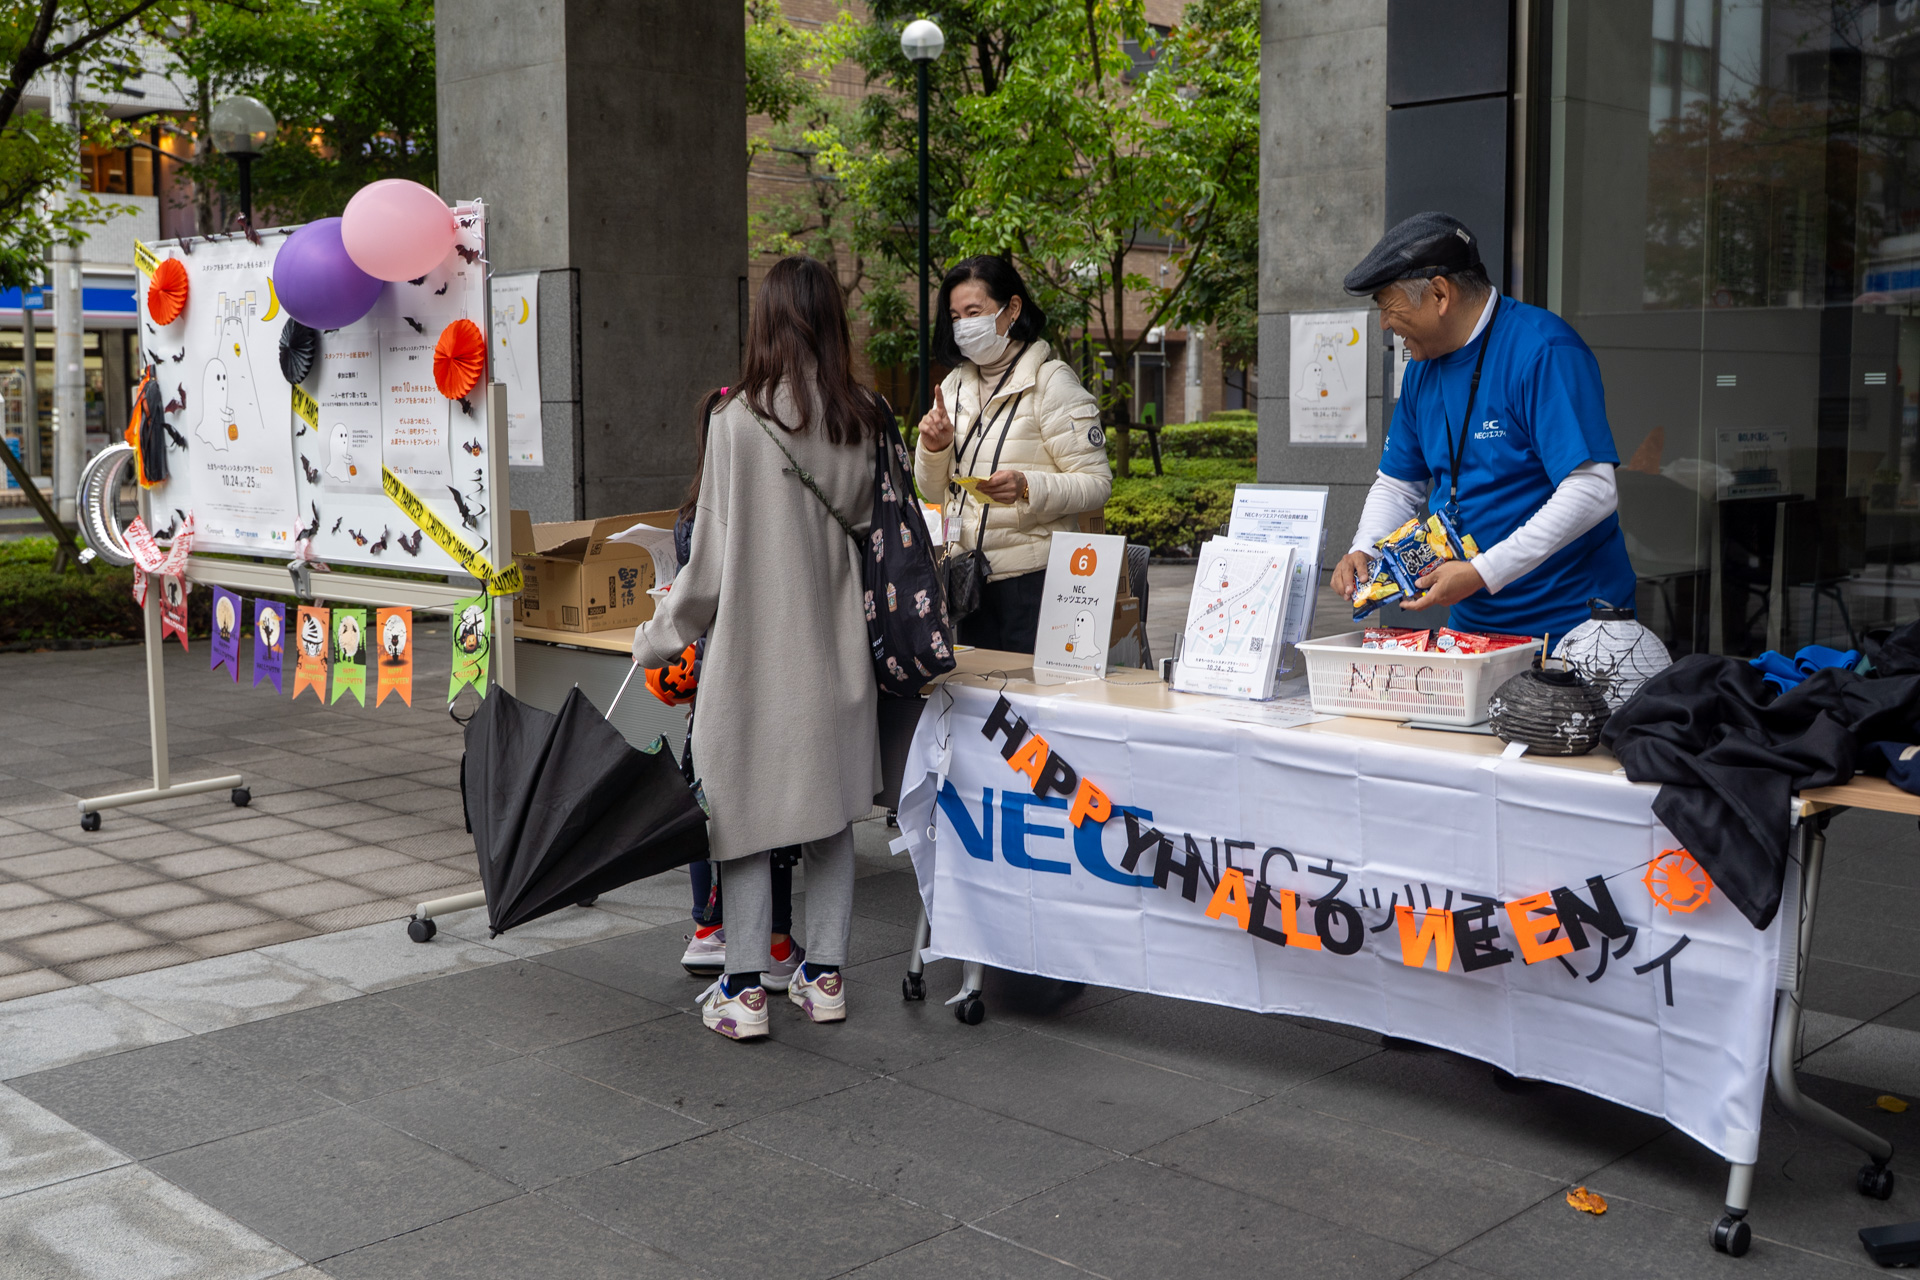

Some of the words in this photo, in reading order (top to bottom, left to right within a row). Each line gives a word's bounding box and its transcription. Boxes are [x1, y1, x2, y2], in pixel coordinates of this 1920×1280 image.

[1078, 554, 1089, 571] 6
[1056, 594, 1100, 607] ネッツエスアイ
[1072, 585, 1087, 594] NEC
[1350, 662, 1435, 696] NEC
[937, 779, 1158, 889] NEC
[981, 694, 1165, 874] HAPPY
[1152, 836, 1629, 974] HALLOWEEN
